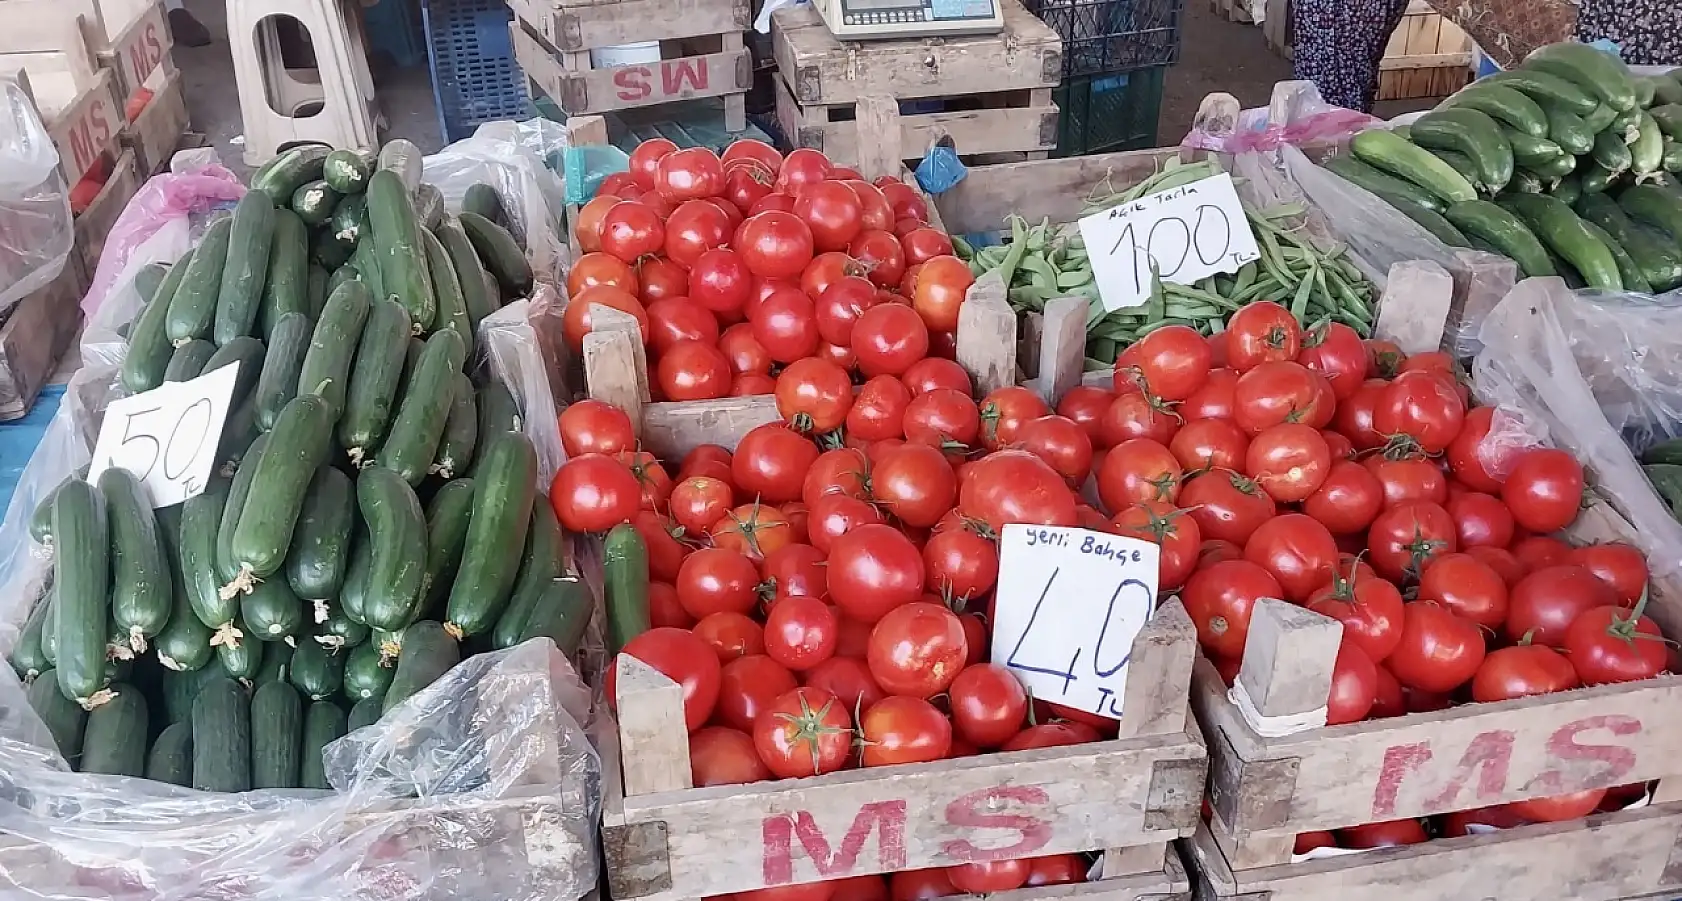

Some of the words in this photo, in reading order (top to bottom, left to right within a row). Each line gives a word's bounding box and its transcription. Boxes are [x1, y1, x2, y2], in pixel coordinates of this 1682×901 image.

[130, 22, 161, 87] MS
[68, 100, 110, 176] MS
[1110, 204, 1230, 295] 100
[121, 397, 212, 482] 50
[181, 475, 201, 498] TL
[1007, 566, 1152, 695] 40
[1095, 687, 1124, 716] TL
[762, 785, 1053, 886] MS
